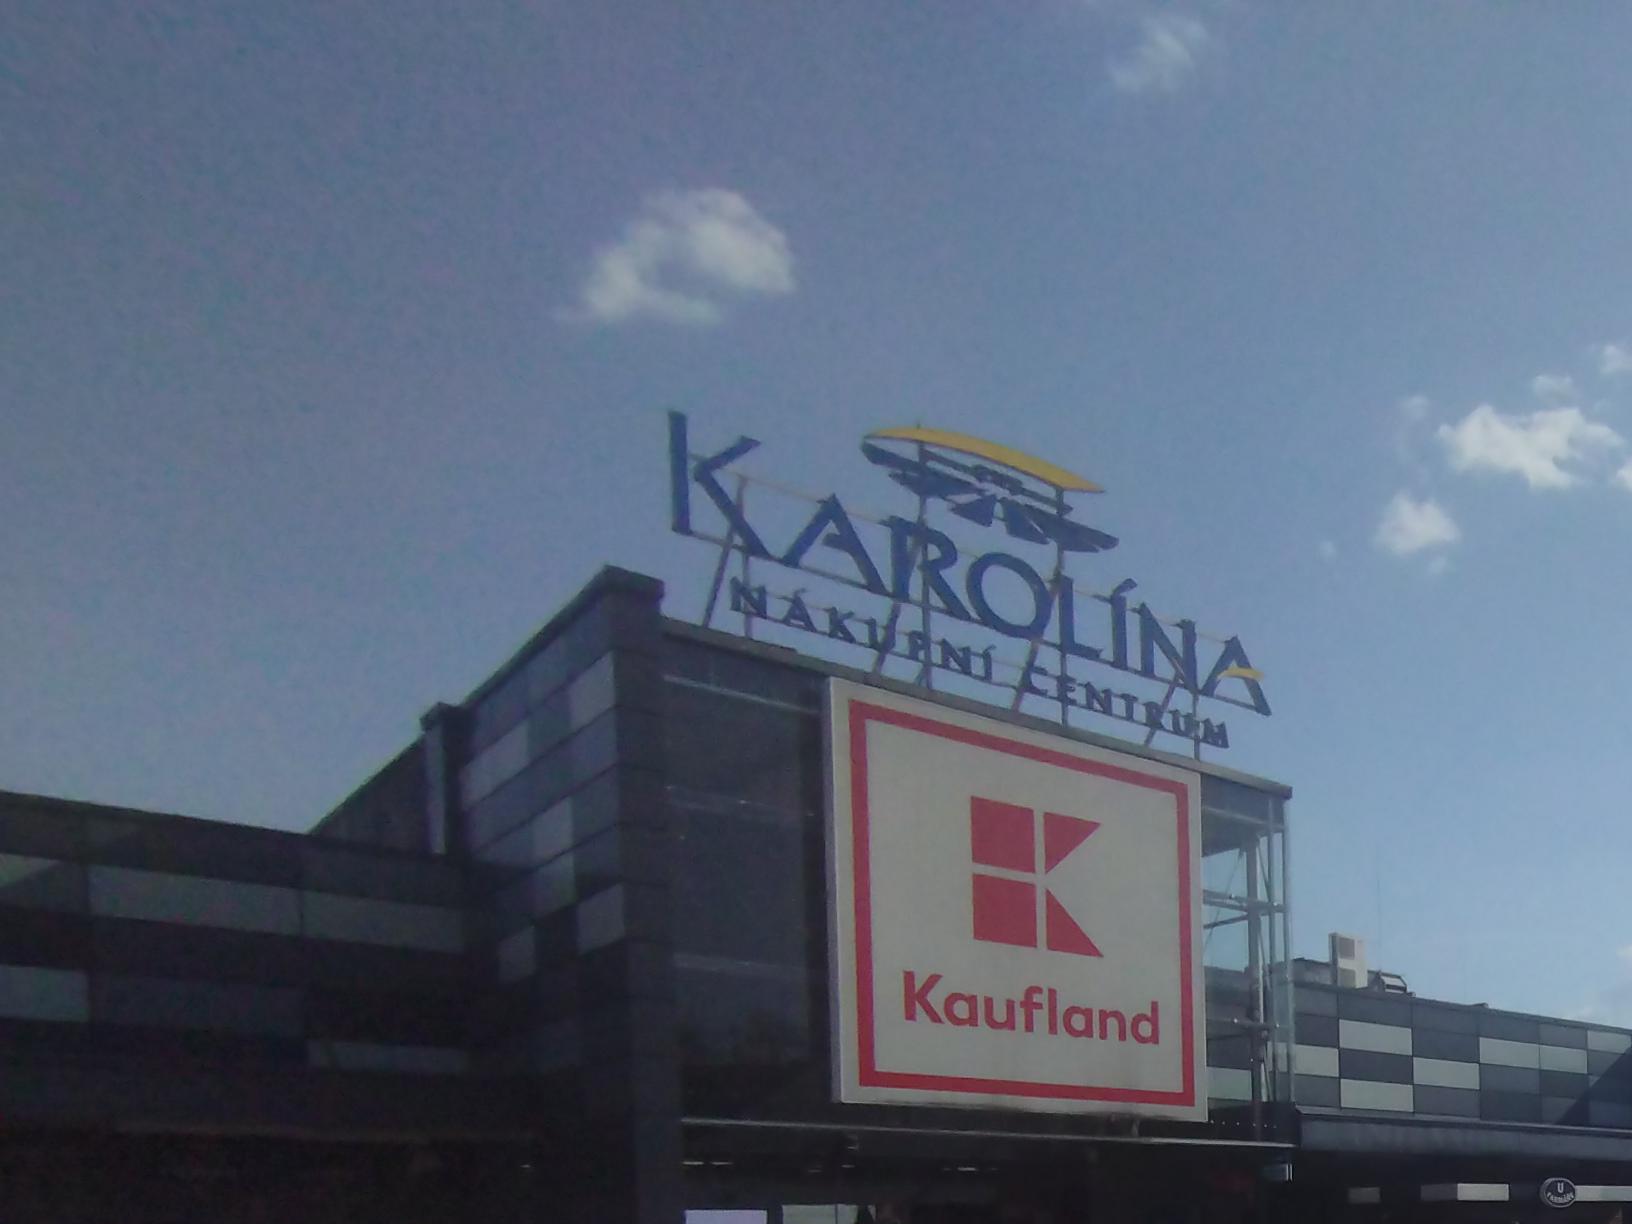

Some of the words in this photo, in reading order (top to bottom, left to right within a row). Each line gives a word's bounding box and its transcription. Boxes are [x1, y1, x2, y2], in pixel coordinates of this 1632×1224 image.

[667, 410, 1272, 717] KAROLÍNA
[730, 576, 997, 682] NÁKUPNÍ
[1019, 664, 1231, 750] CENTRUM
[903, 970, 1161, 1046] Kaufland
